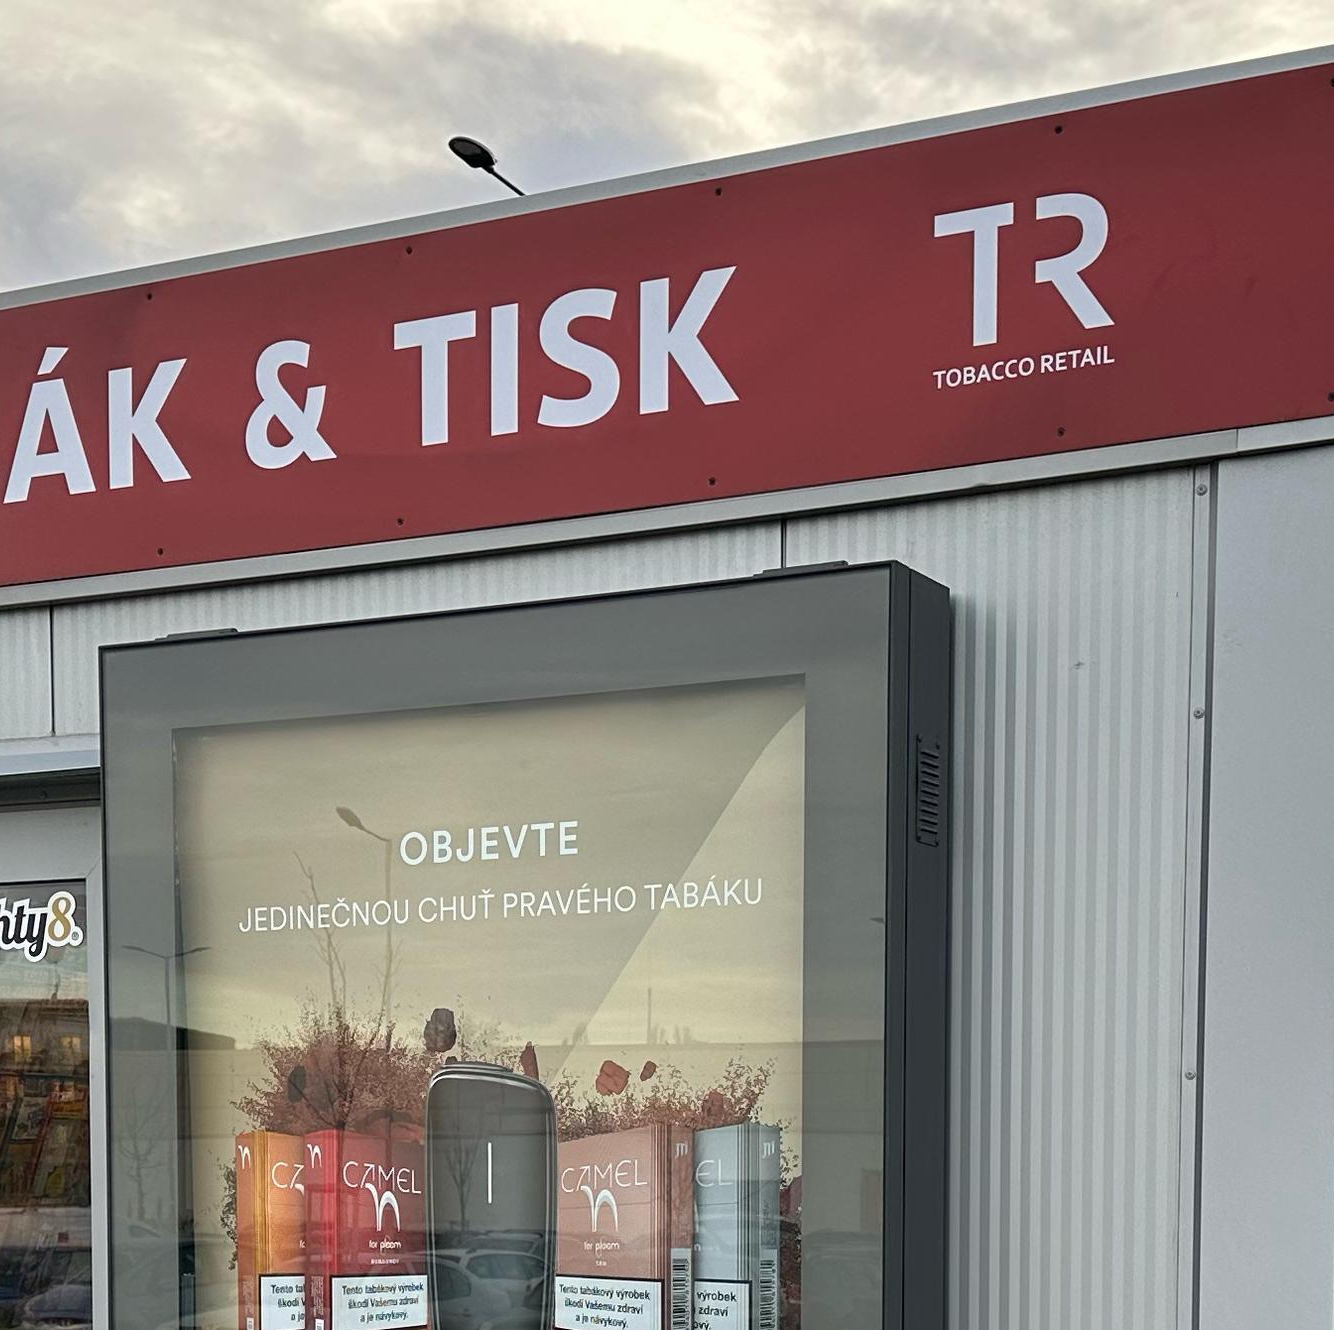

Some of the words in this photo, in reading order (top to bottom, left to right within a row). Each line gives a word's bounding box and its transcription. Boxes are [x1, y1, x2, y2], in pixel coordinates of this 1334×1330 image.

[934, 192, 1115, 348] TR
[246, 338, 337, 470] &
[393, 266, 740, 447] TISK
[933, 355, 1035, 390] TOBACCO
[1039, 345, 1115, 374] RETAIL
[399, 820, 580, 866] OBJEVTE
[238, 892, 410, 934] JEDINEČNOU
[417, 885, 497, 924] CHUŤ
[502, 880, 637, 919] PRAVÉHO
[643, 873, 764, 911] TABÁKU
[342, 1160, 422, 1194] CAMEL
[561, 1159, 648, 1193] CAMEL
[271, 1284, 293, 1296] Tento
[342, 1284, 363, 1296] Tento
[559, 1283, 579, 1295] Tento
[616, 1285, 650, 1302] výrobek
[696, 1290, 737, 1304] výrobek
[617, 1302, 643, 1315] zdraví
